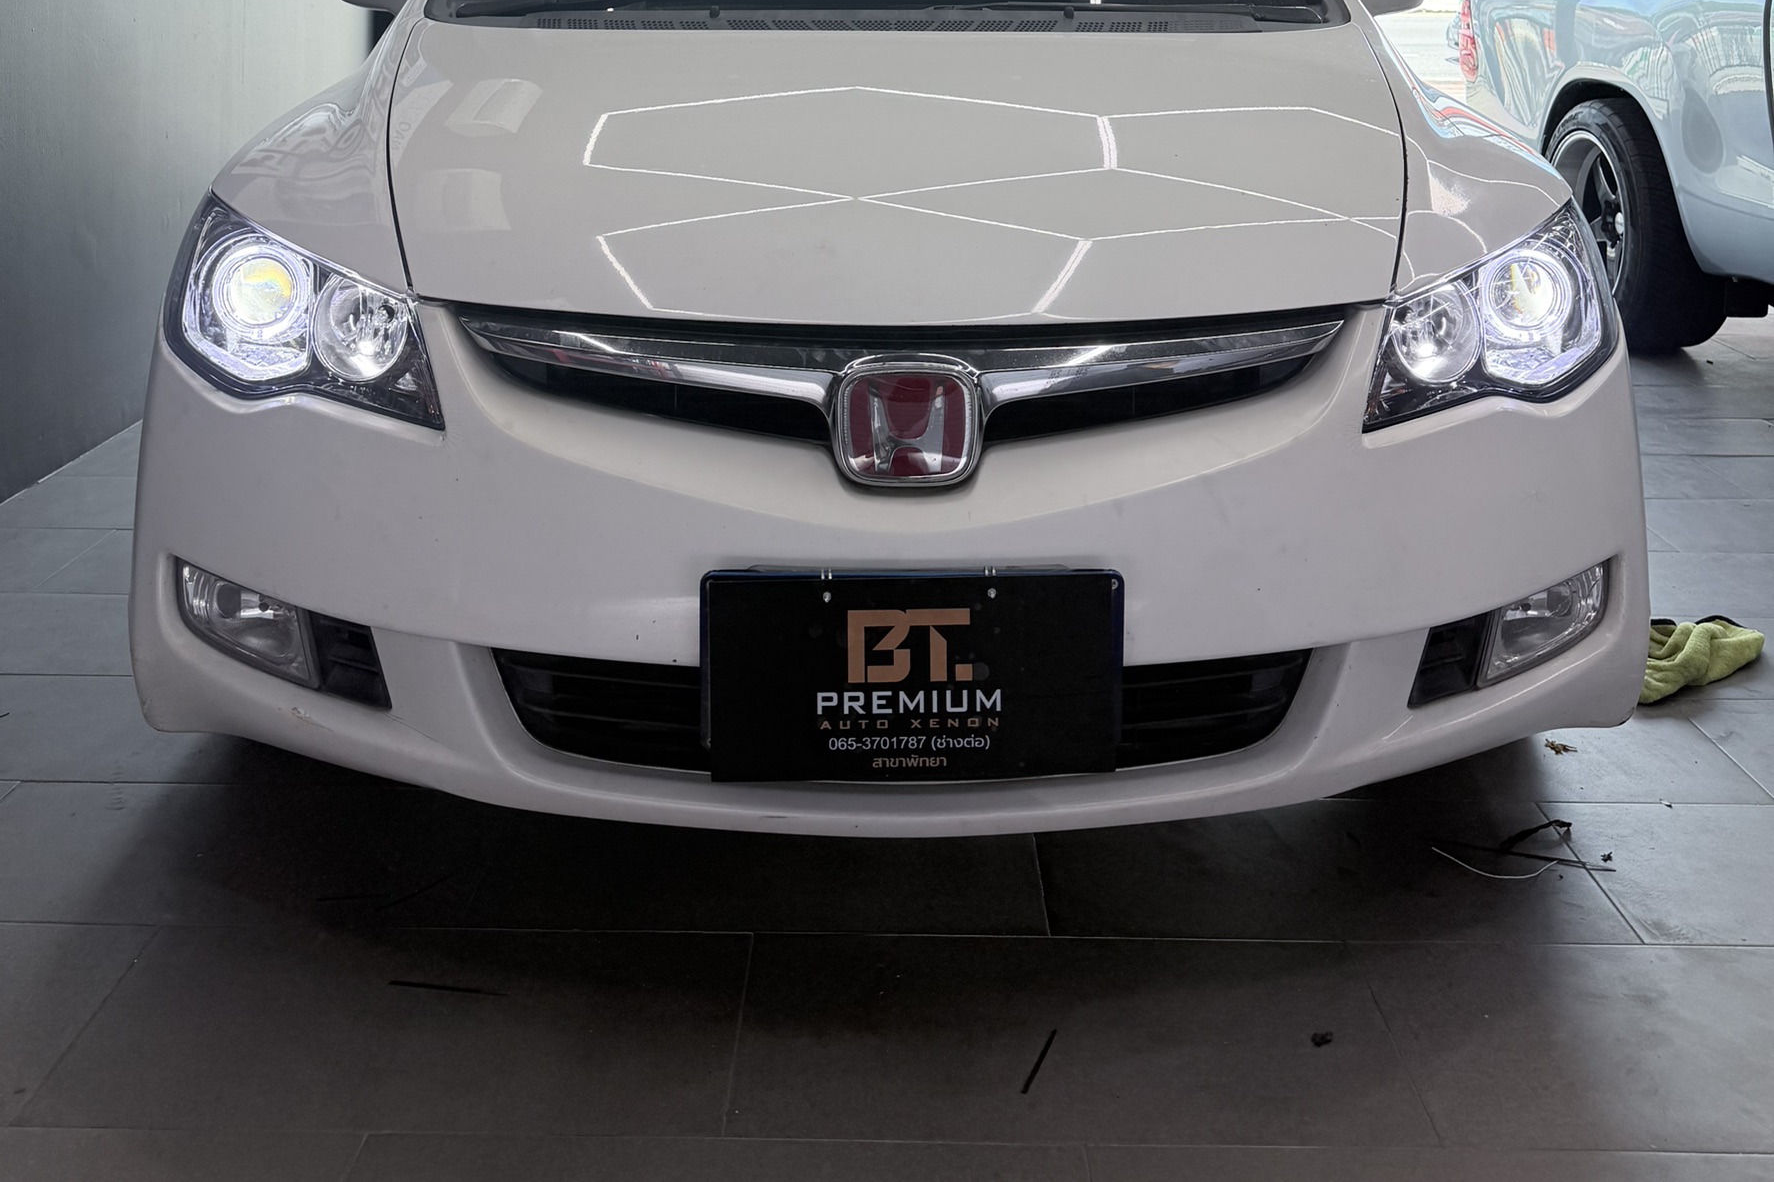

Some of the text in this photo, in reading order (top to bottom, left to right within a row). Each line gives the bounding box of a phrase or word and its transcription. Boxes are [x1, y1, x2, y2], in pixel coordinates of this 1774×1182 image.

[817, 689, 1002, 715] PREMIUM
[820, 717, 1000, 730] AUTO XENON
[828, 735, 991, 751] 065-3701787 (ช่างต่อ)
[872, 753, 948, 768] สาขาพัทยา
